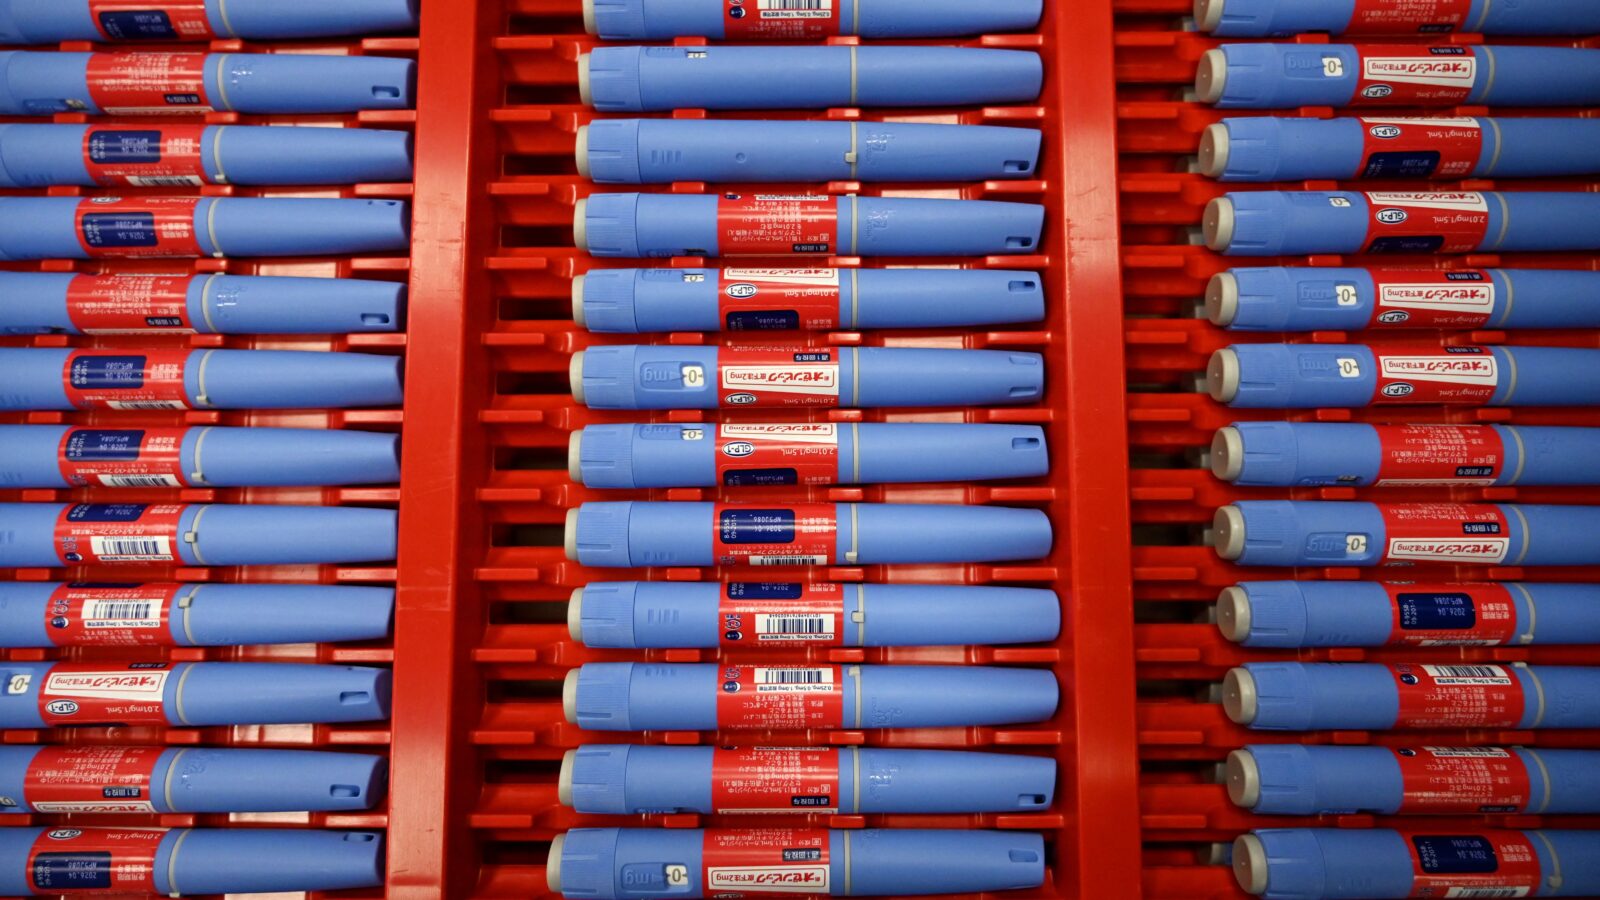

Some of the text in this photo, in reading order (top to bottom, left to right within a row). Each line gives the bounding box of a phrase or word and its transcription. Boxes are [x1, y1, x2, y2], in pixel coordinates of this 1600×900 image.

[1374, 128, 1398, 136] GLP-1
[1426, 129, 1478, 138] 2.01mg/1.5mL
[1380, 212, 1404, 220] GLP-1
[1432, 214, 1486, 224] 2.01mg/1.5mL
[730, 286, 754, 295] GLP-1
[1382, 314, 1406, 322] GLP-1
[642, 368, 668, 382] mg
[1386, 386, 1410, 394] GLP-1
[730, 396, 754, 404] GLP-1
[726, 444, 752, 454] GLP-1
[780, 448, 834, 456] 2.01mg/1.5mL
[50, 702, 75, 711] GLP-1
[105, 706, 160, 714] 2.01mg/1.5mL
[784, 850, 820, 860] 週1回投与
[626, 872, 650, 884] mg
